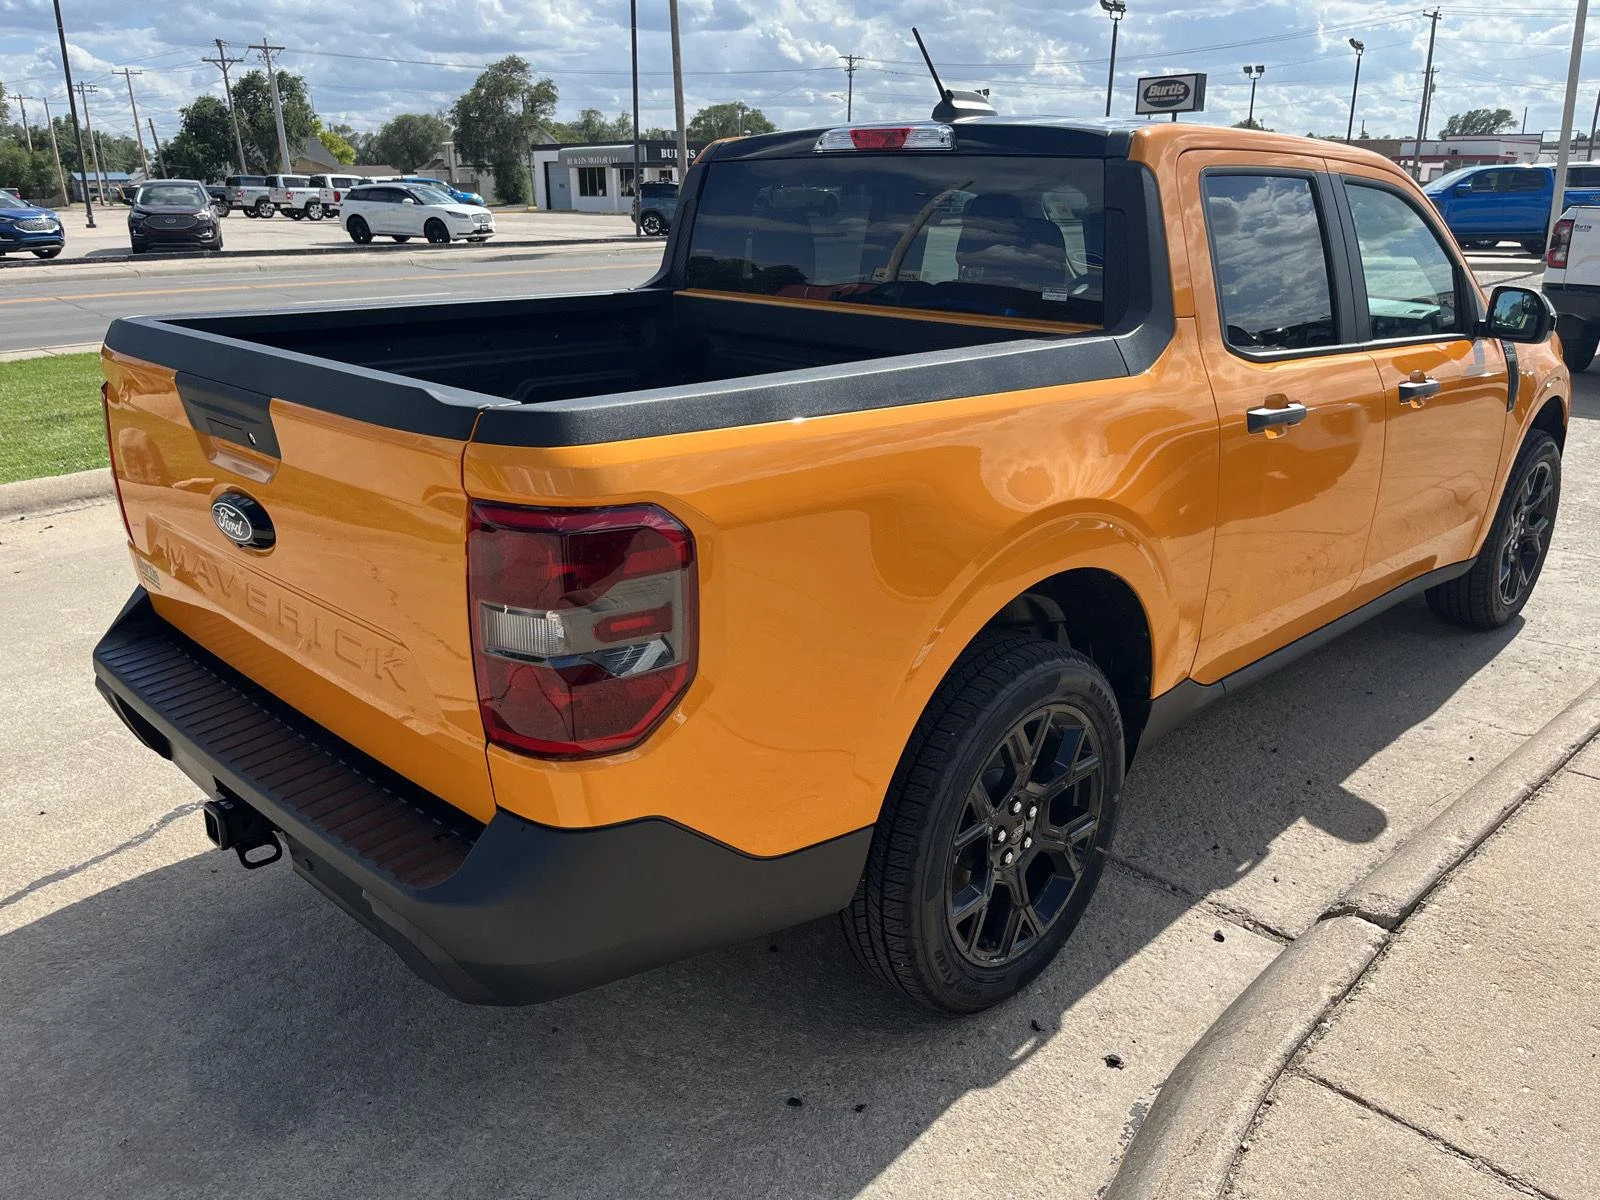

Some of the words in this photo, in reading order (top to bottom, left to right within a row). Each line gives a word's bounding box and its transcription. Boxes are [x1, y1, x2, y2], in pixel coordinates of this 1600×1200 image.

[1148, 83, 1186, 96] Burtis
[661, 149, 696, 159] BUIS
[214, 506, 244, 536] Ford
[164, 538, 407, 692] MAVERICK
